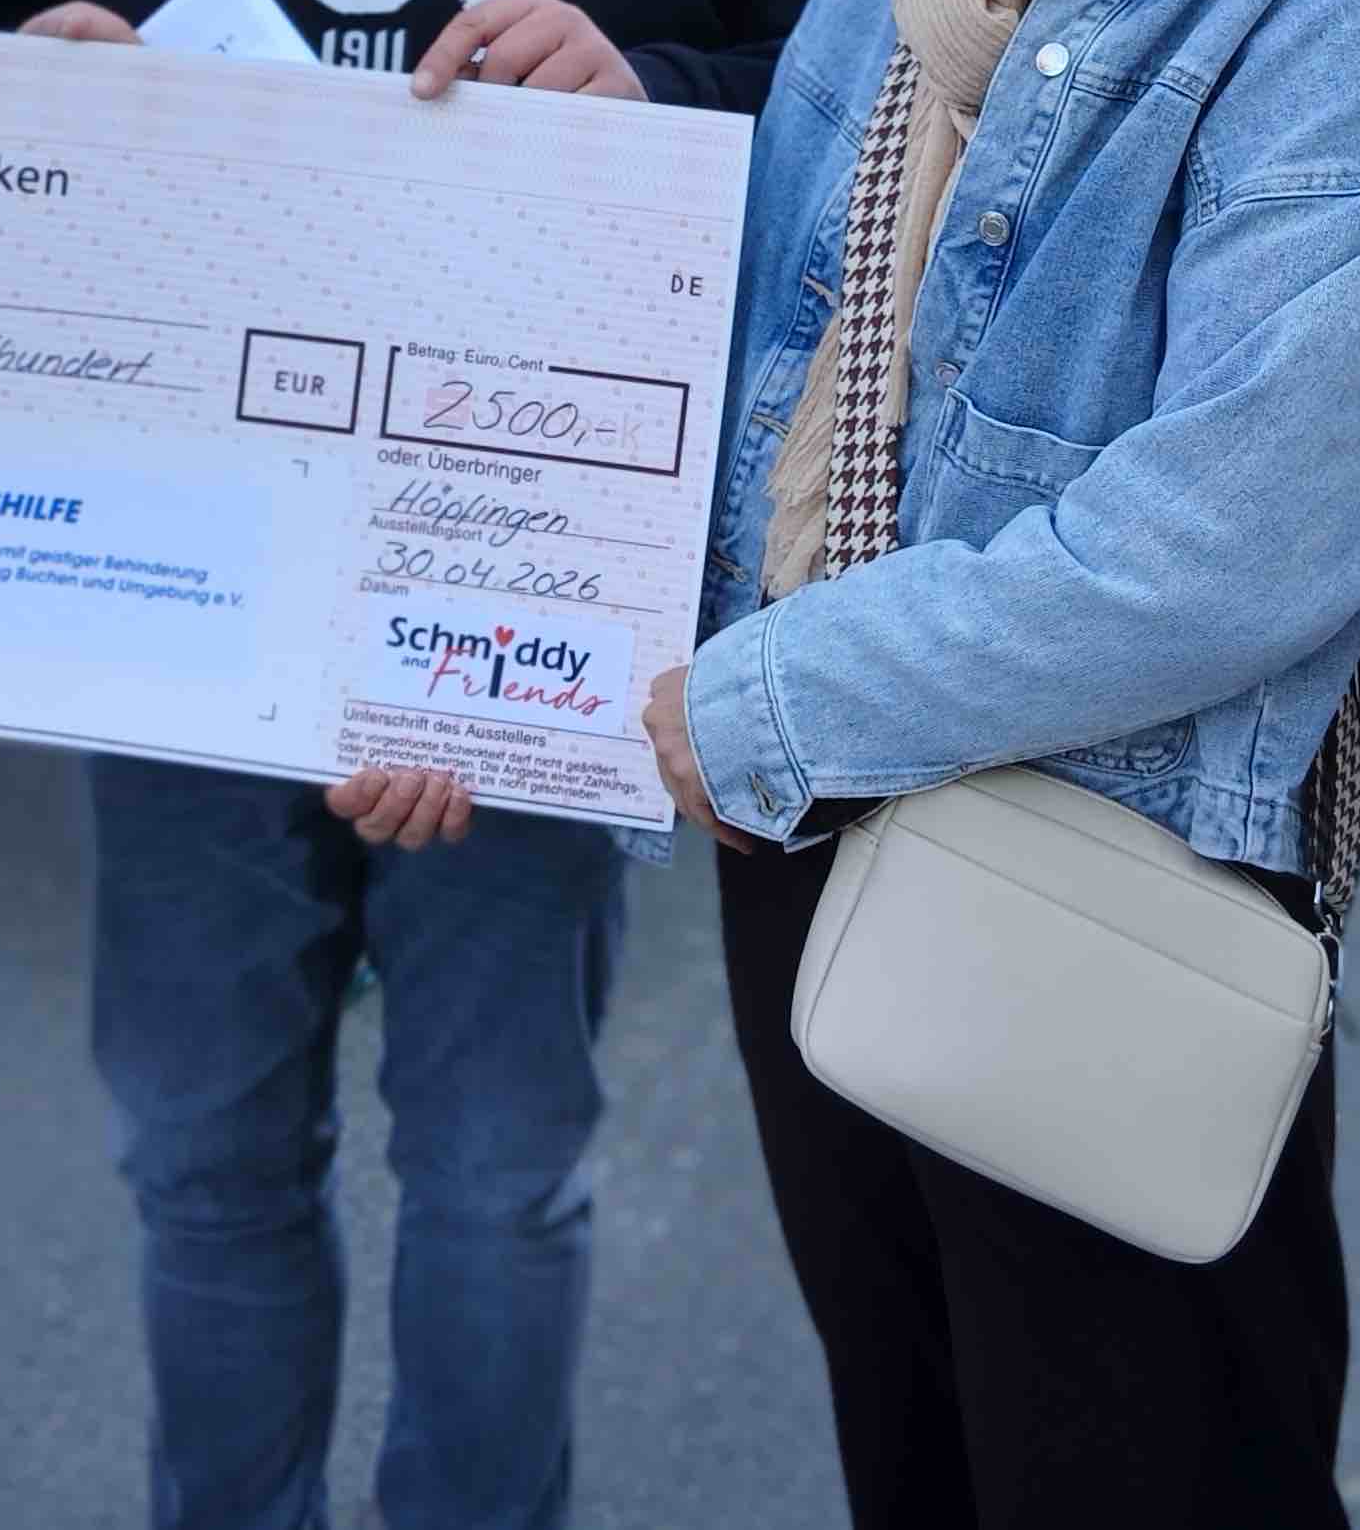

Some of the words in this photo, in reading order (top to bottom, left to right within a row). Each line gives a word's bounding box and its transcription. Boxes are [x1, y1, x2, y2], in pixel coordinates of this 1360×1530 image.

[671, 274, 703, 296] DE
[508, 356, 543, 372] Cent
[275, 370, 326, 397] EUR
[377, 448, 419, 467] oder
[428, 447, 542, 484] Überbringer
[390, 478, 568, 547] Höpfingen
[29, 548, 102, 569] geistiger
[104, 555, 208, 585] Behinderung
[15, 567, 78, 586] Buchen
[82, 577, 114, 590] und
[118, 579, 209, 606] Umgebung
[359, 576, 410, 596] Datum
[386, 616, 591, 698] Schmiddy
[401, 655, 431, 669] and
[343, 705, 429, 731] Unterschrift
[433, 720, 461, 735] des
[464, 722, 546, 747] Ausstellers
[338, 742, 364, 753] oder
[368, 746, 429, 764] gestrichen
[503, 763, 547, 780] Angabe
[551, 771, 580, 783] einer
[340, 728, 362, 741] Der
[365, 733, 439, 752] vorgedruckte
[508, 751, 532, 763] darf
[534, 757, 563, 770] nicht
[499, 777, 527, 790] nicht
